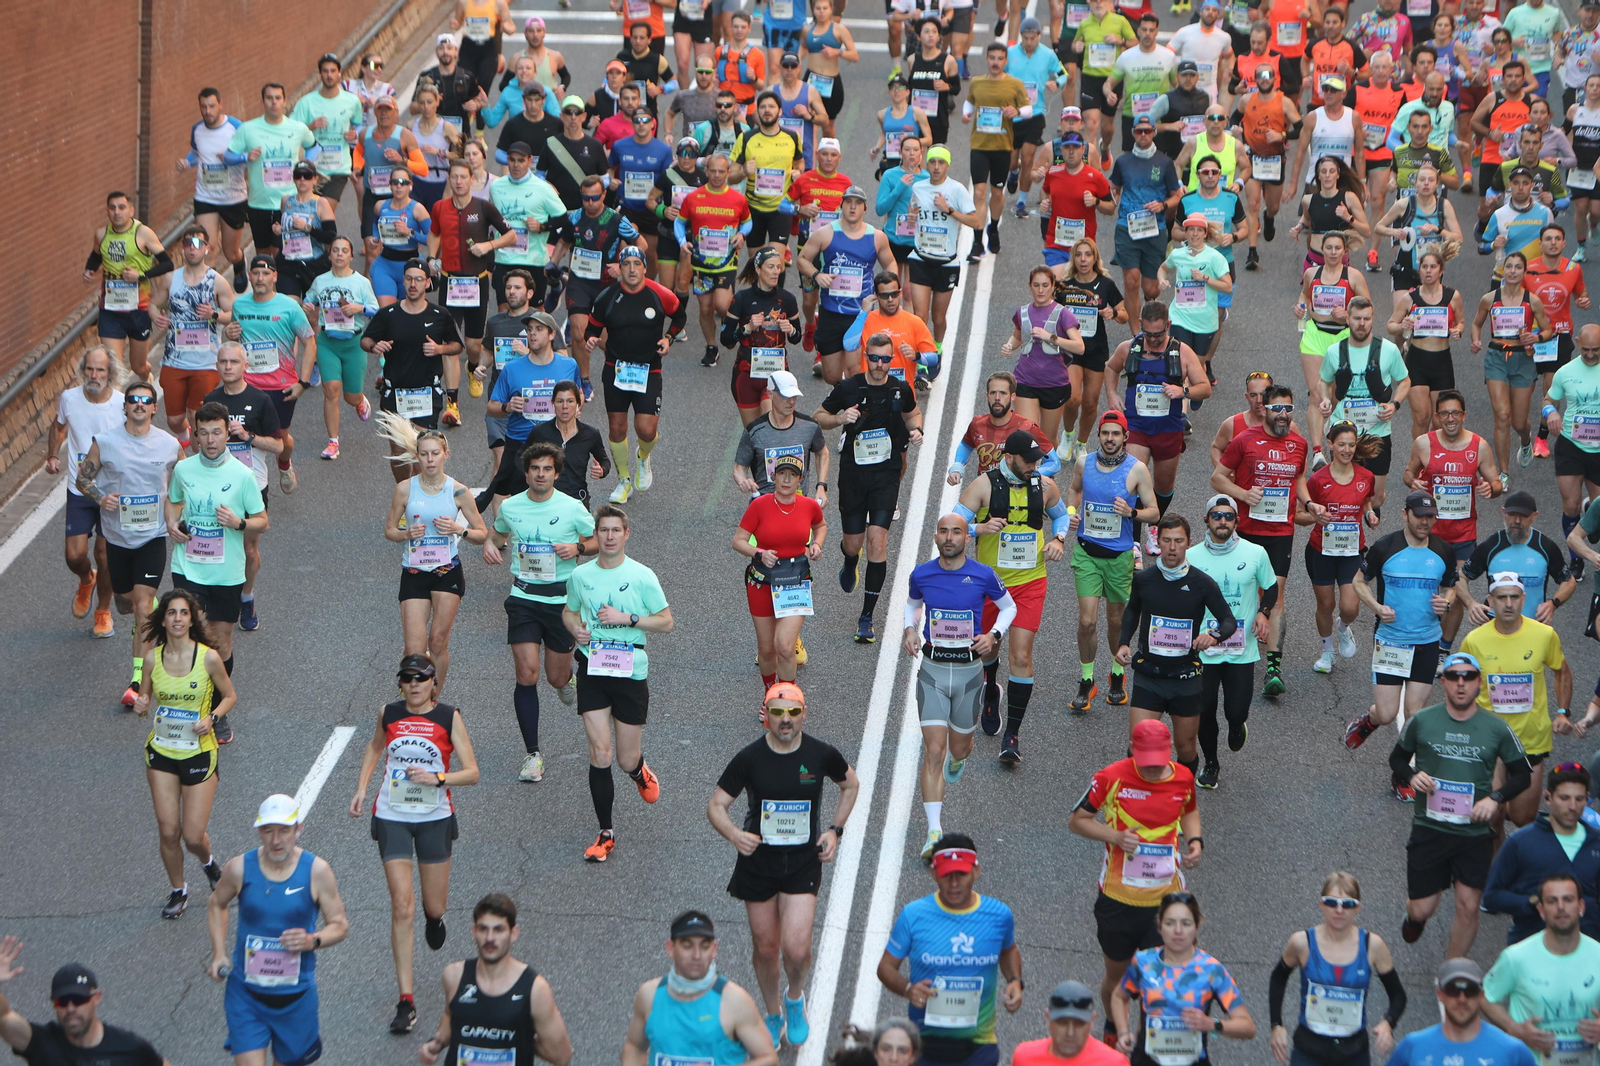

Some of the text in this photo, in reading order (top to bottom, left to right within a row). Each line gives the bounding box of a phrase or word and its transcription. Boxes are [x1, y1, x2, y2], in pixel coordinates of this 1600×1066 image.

[1364, 110, 1391, 118] ASFAS
[1501, 112, 1528, 120] ASFAS
[696, 206, 735, 216] INDEPENDIENTES
[1065, 219, 1082, 227] ZURICH
[1504, 219, 1543, 227] CANARIAS
[580, 250, 598, 258] ZURICH
[865, 430, 885, 438] ZURICH
[779, 448, 799, 456] ZURICH
[134, 496, 154, 504] ZURICH
[1390, 579, 1416, 588] MEDIA
[1154, 641, 1186, 649] LEICHSENRING
[934, 651, 968, 659] WONG
[169, 710, 193, 719] ZURICH
[390, 739, 438, 759] ALMAGRO
[1434, 743, 1481, 759] FINISHER
[1442, 783, 1468, 792] ZURICH
[779, 803, 805, 811] ZURICH
[1144, 846, 1168, 854] ZURICH
[949, 981, 976, 989] ZURICH
[1327, 990, 1356, 1000] ZURICH
[461, 1025, 516, 1041] CAPACITY
[478, 1052, 507, 1061] ZURICH
